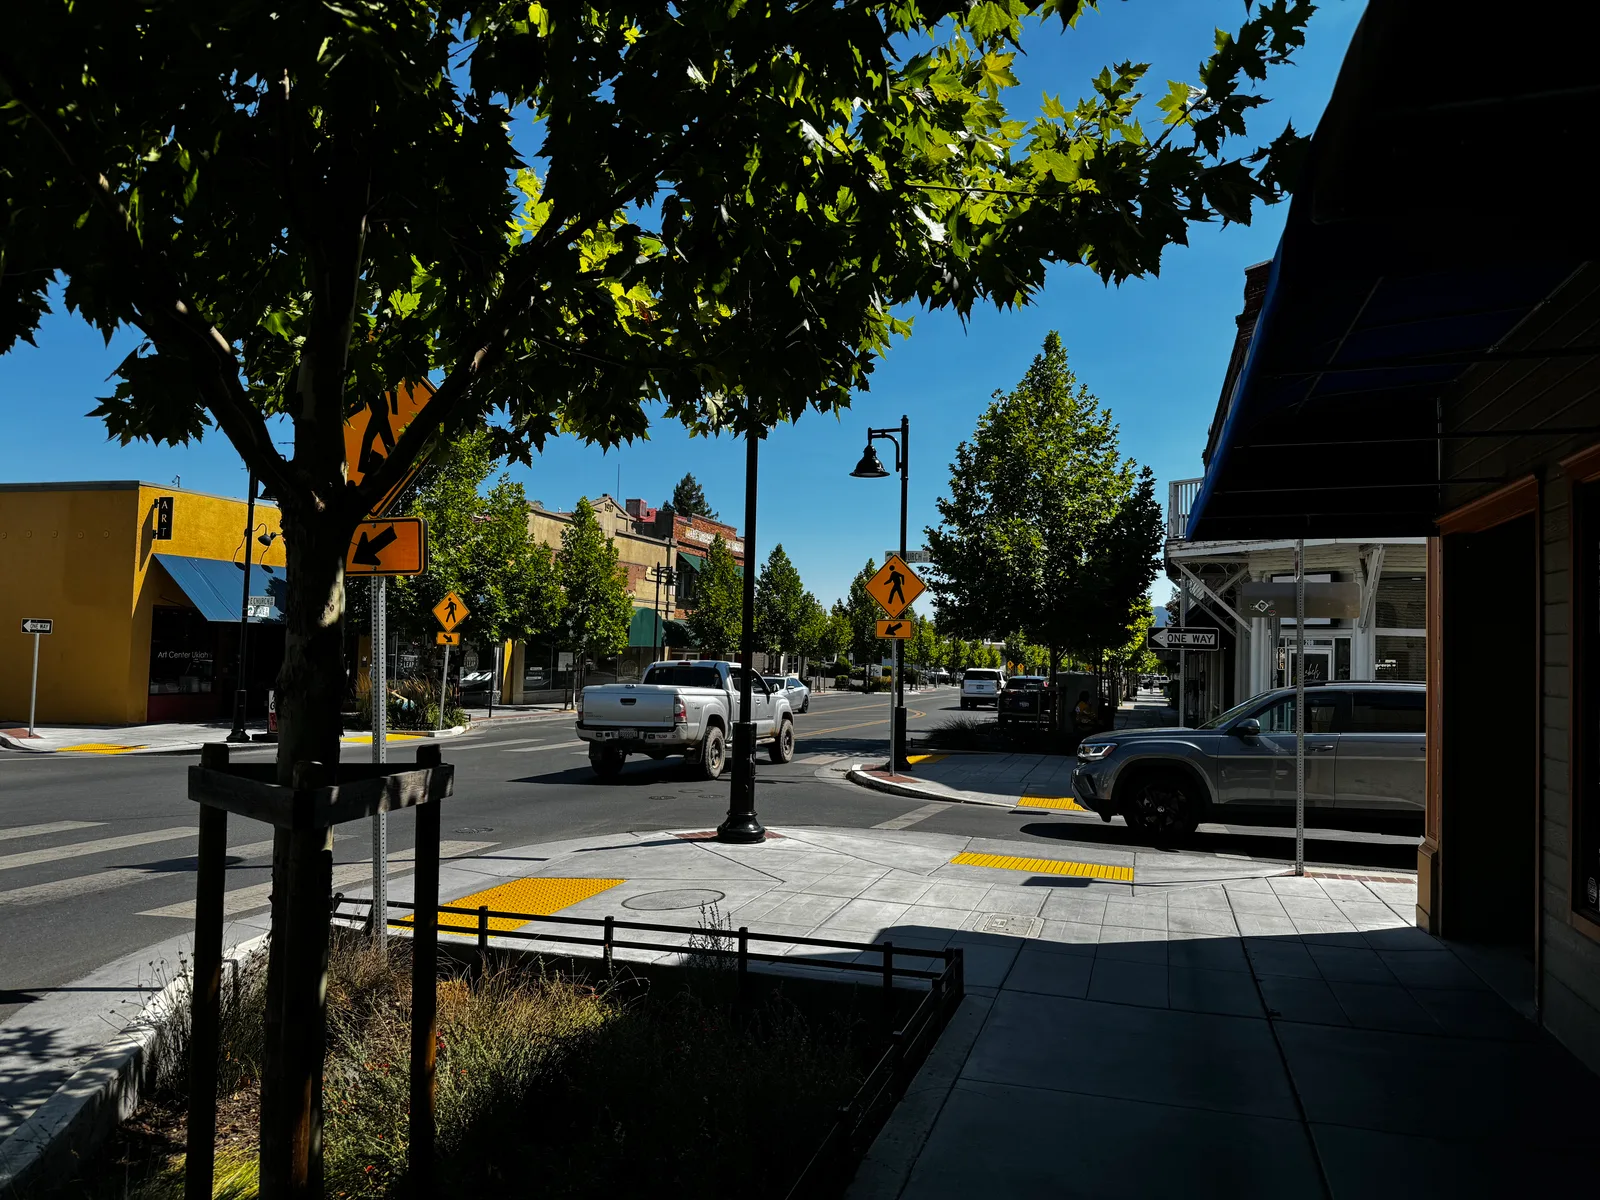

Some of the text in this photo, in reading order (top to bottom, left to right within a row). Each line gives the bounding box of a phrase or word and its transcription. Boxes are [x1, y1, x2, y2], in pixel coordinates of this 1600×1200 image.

[1167, 633, 1214, 644] ONE WAY
[157, 651, 167, 659] Art
[168, 651, 190, 659] Center
